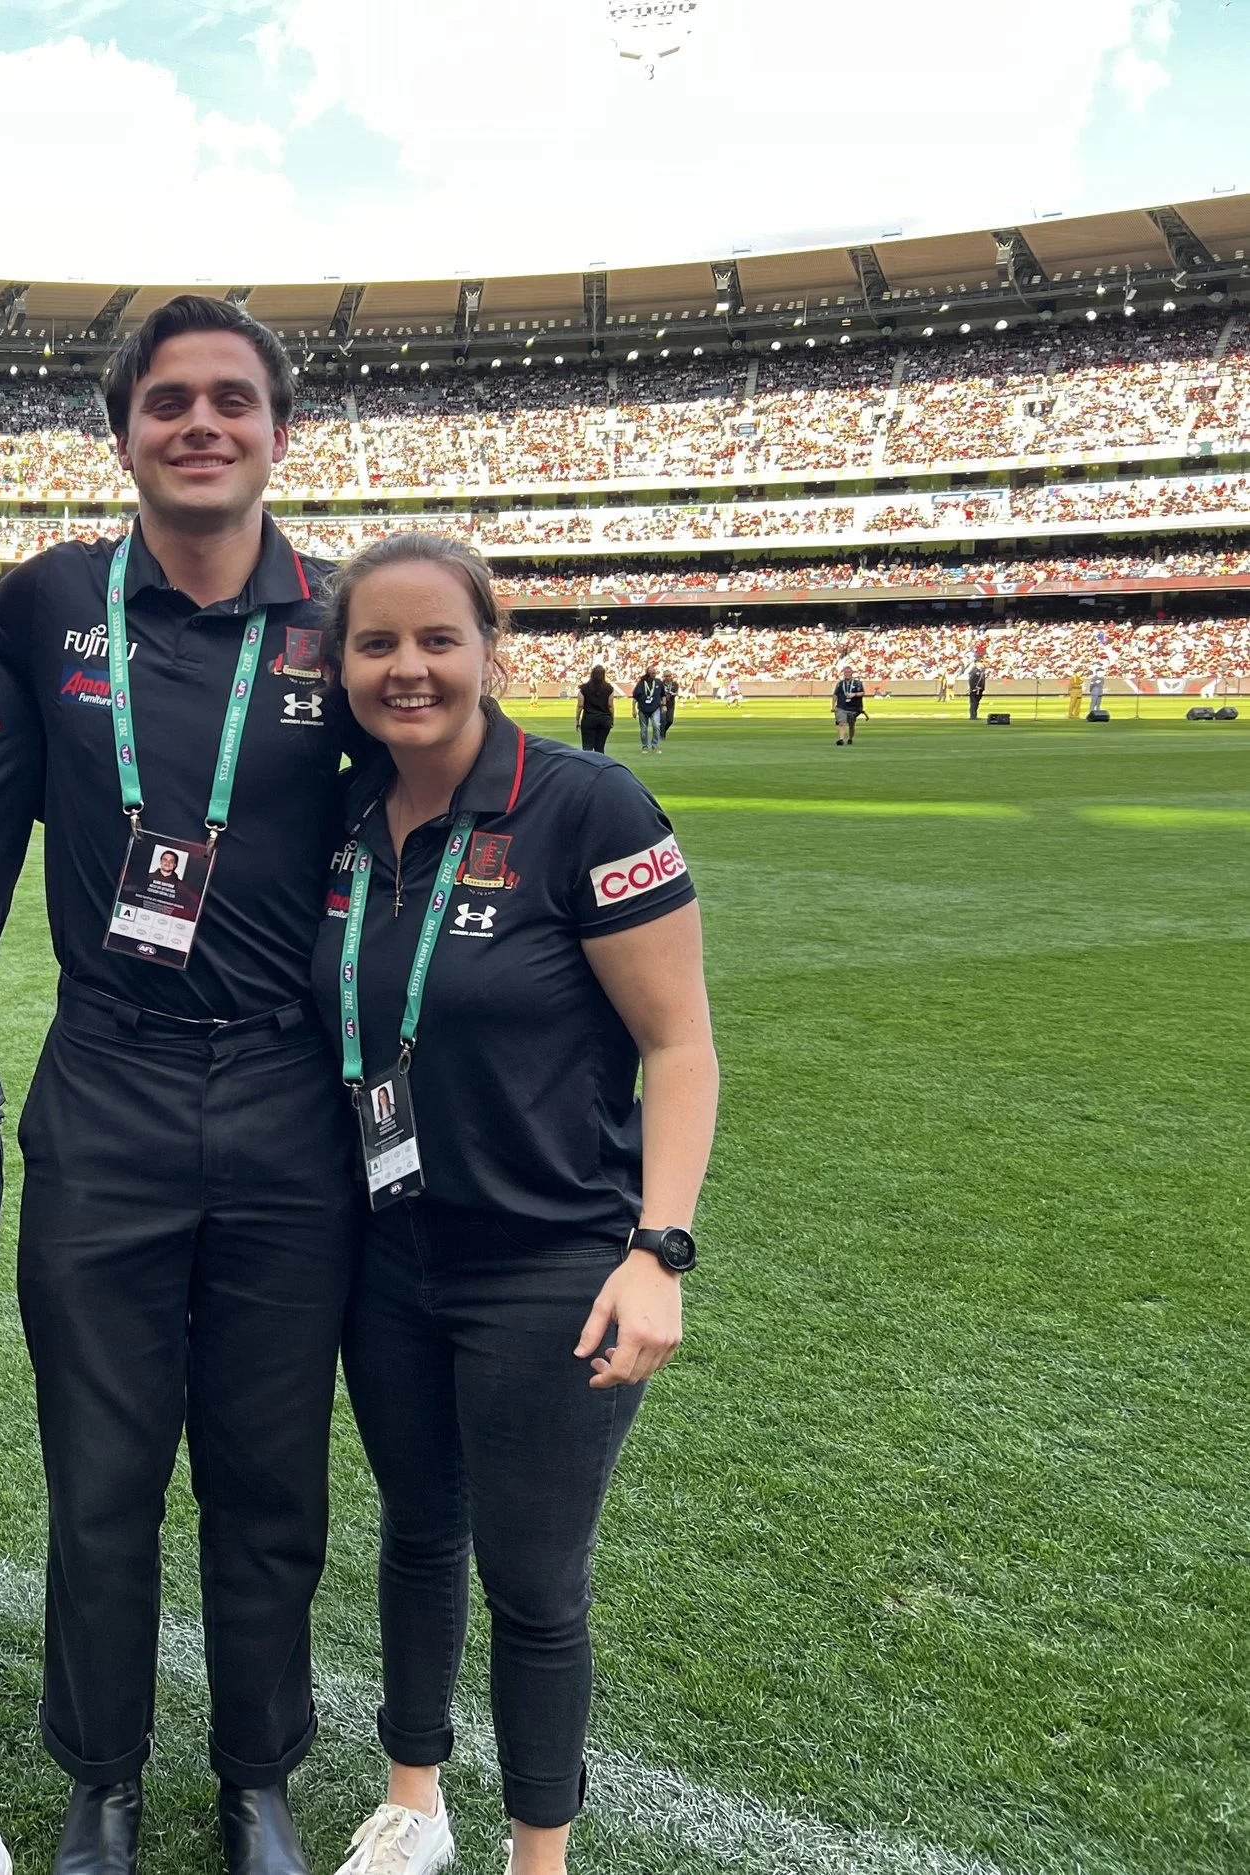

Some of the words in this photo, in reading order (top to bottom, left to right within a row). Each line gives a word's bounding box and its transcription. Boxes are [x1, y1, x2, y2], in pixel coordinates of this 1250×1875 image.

[64, 624, 138, 661] FUJITU
[248, 627, 258, 645] AFL
[241, 653, 254, 672] 2022
[61, 671, 111, 697] Amar
[236, 681, 247, 699] AFL
[78, 692, 112, 706] Furniture
[116, 690, 124, 708] AFL
[118, 717, 128, 737] 2022
[230, 706, 241, 728] DAILY
[224, 727, 237, 753] ARENA
[122, 745, 130, 764] AFL
[219, 754, 232, 781] ACCESS
[451, 836, 462, 855] AFL
[359, 854, 367, 872] AFL
[601, 845, 683, 898] coles
[441, 863, 454, 884] 2022
[353, 881, 364, 906] ACCESS
[433, 892, 444, 912] AFL
[123, 909, 131, 917] A
[350, 907, 360, 932] ARENA
[423, 919, 436, 943] DAILY
[138, 944, 155, 955] AFL
[347, 933, 356, 954] DAILY
[416, 943, 429, 968] ARENA
[344, 962, 352, 981] AFL
[410, 969, 423, 997] ACCESS
[344, 990, 353, 1010] 2022
[346, 1019, 354, 1038] AFL
[372, 1162, 379, 1171] A
[390, 1184, 402, 1194] AFL
